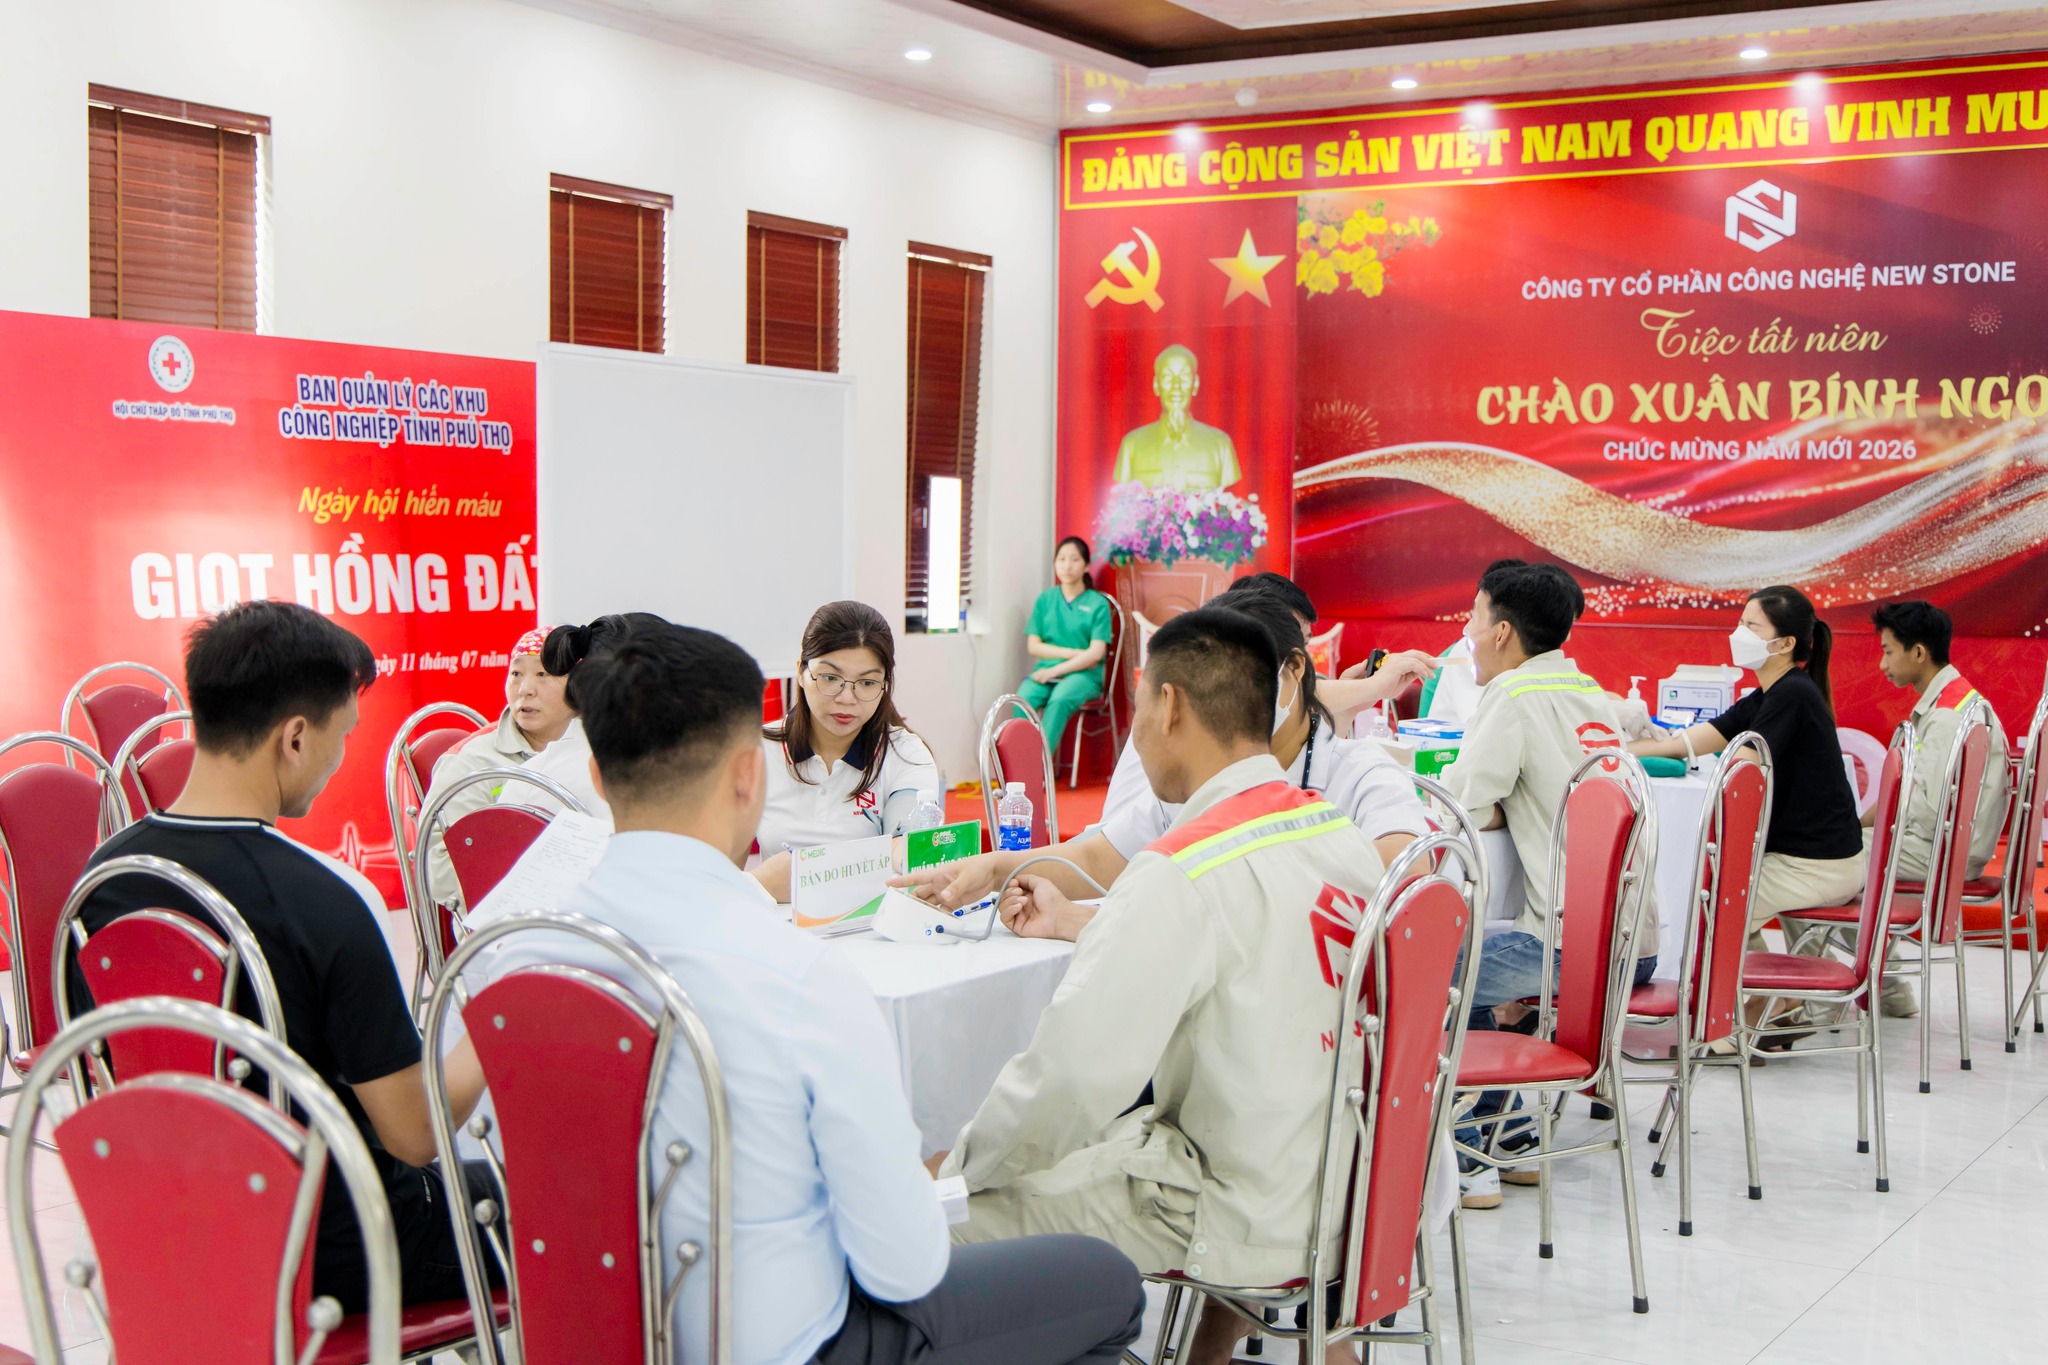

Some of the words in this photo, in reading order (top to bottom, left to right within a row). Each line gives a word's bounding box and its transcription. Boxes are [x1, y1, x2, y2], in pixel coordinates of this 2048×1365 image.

[1081, 147, 1187, 193] ĐẢNG
[1199, 141, 1303, 190] CỘNG
[1315, 130, 1401, 178] SẢN
[1412, 124, 1510, 175] VIỆT
[1521, 119, 1632, 164] NAM
[1645, 107, 1810, 163] QUANG
[1825, 96, 1951, 143] VINH
[1522, 278, 1583, 300] CÔNG
[1588, 277, 1617, 297] TY
[1621, 271, 1654, 297] CỔ
[1658, 268, 1722, 295] PHẦN
[1727, 267, 1794, 292] CÔNG
[1799, 262, 1865, 292] NGHỆ
[1871, 264, 1927, 287] NEW
[1932, 261, 2016, 284] STONE
[1640, 307, 1740, 363] Tiệc
[1748, 318, 1799, 356] tất
[1804, 322, 1889, 354] niên
[299, 377, 336, 402] BAN
[342, 374, 389, 406] QUẢN
[394, 379, 412, 407] LÝ
[418, 381, 449, 411] CÁC
[455, 389, 486, 413] KHU
[1477, 377, 1614, 425] CHÀO
[1629, 373, 1771, 425] XUÂN
[1789, 371, 1919, 423] BÍNH
[1939, 374, 2048, 426] NGỌ
[281, 406, 331, 437] CÔNG
[336, 411, 399, 446] NGHIỆP
[404, 411, 441, 443] TỈNH
[446, 417, 478, 445] PHÚ
[481, 424, 511, 453] THỌ
[1603, 436, 1665, 461] CHÚC
[1670, 435, 1740, 461] MỪNG
[1746, 436, 1800, 460] NĂM
[1806, 436, 1854, 461] MỚI
[1858, 438, 1917, 460] 2026
[298, 486, 360, 524] Ngày
[363, 487, 401, 522] hội
[404, 483, 450, 516] hiến
[455, 491, 502, 517] máu
[293, 532, 450, 615] HỒNG
[465, 534, 537, 612] ĐẤ
[374, 653, 398, 677] gày
[401, 652, 416, 672] 11
[419, 650, 458, 674] tháng
[461, 650, 478, 668] 07
[480, 651, 509, 668] năm
[800, 870, 822, 888] BÀN
[877, 854, 890, 870] ÁP
[807, 848, 826, 859] MEDIC
